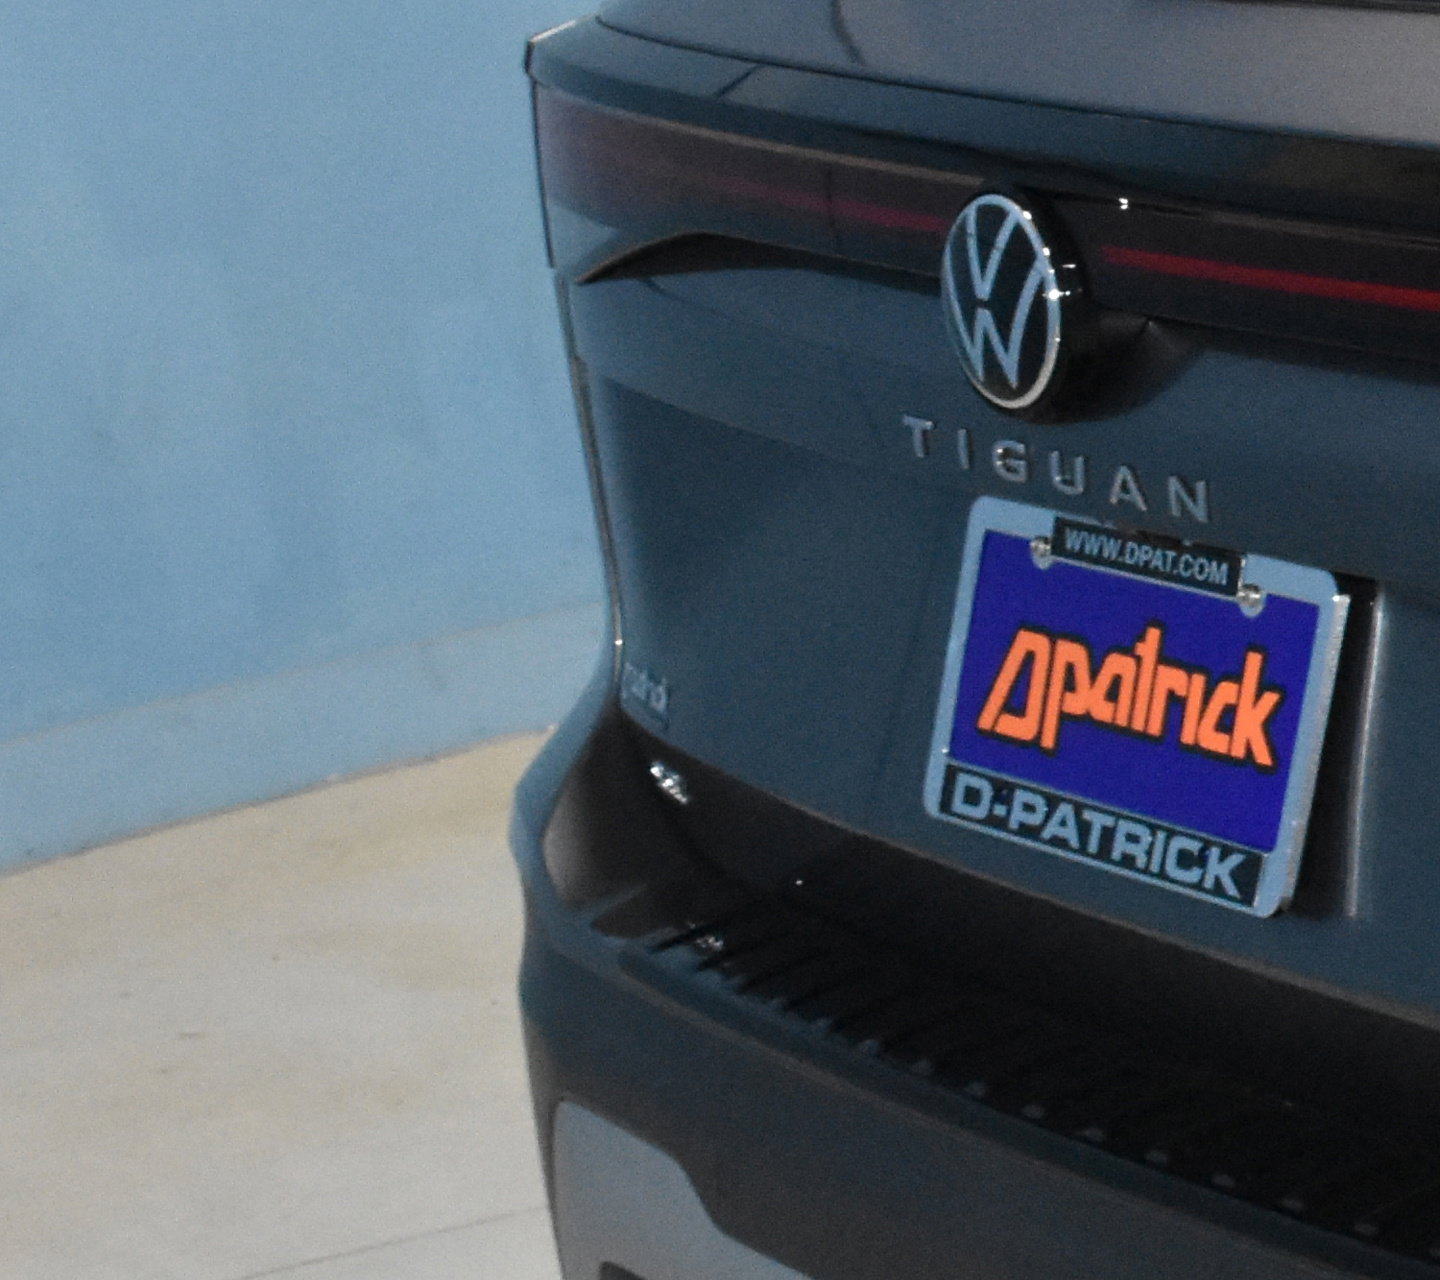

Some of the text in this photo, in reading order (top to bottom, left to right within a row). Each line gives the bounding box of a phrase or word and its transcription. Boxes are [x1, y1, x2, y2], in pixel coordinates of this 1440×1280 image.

[903, 414, 1209, 522] TIGUAN
[1063, 526, 1230, 587] WWW.DPAT.COM
[950, 772, 1247, 899] D-PATRICK
